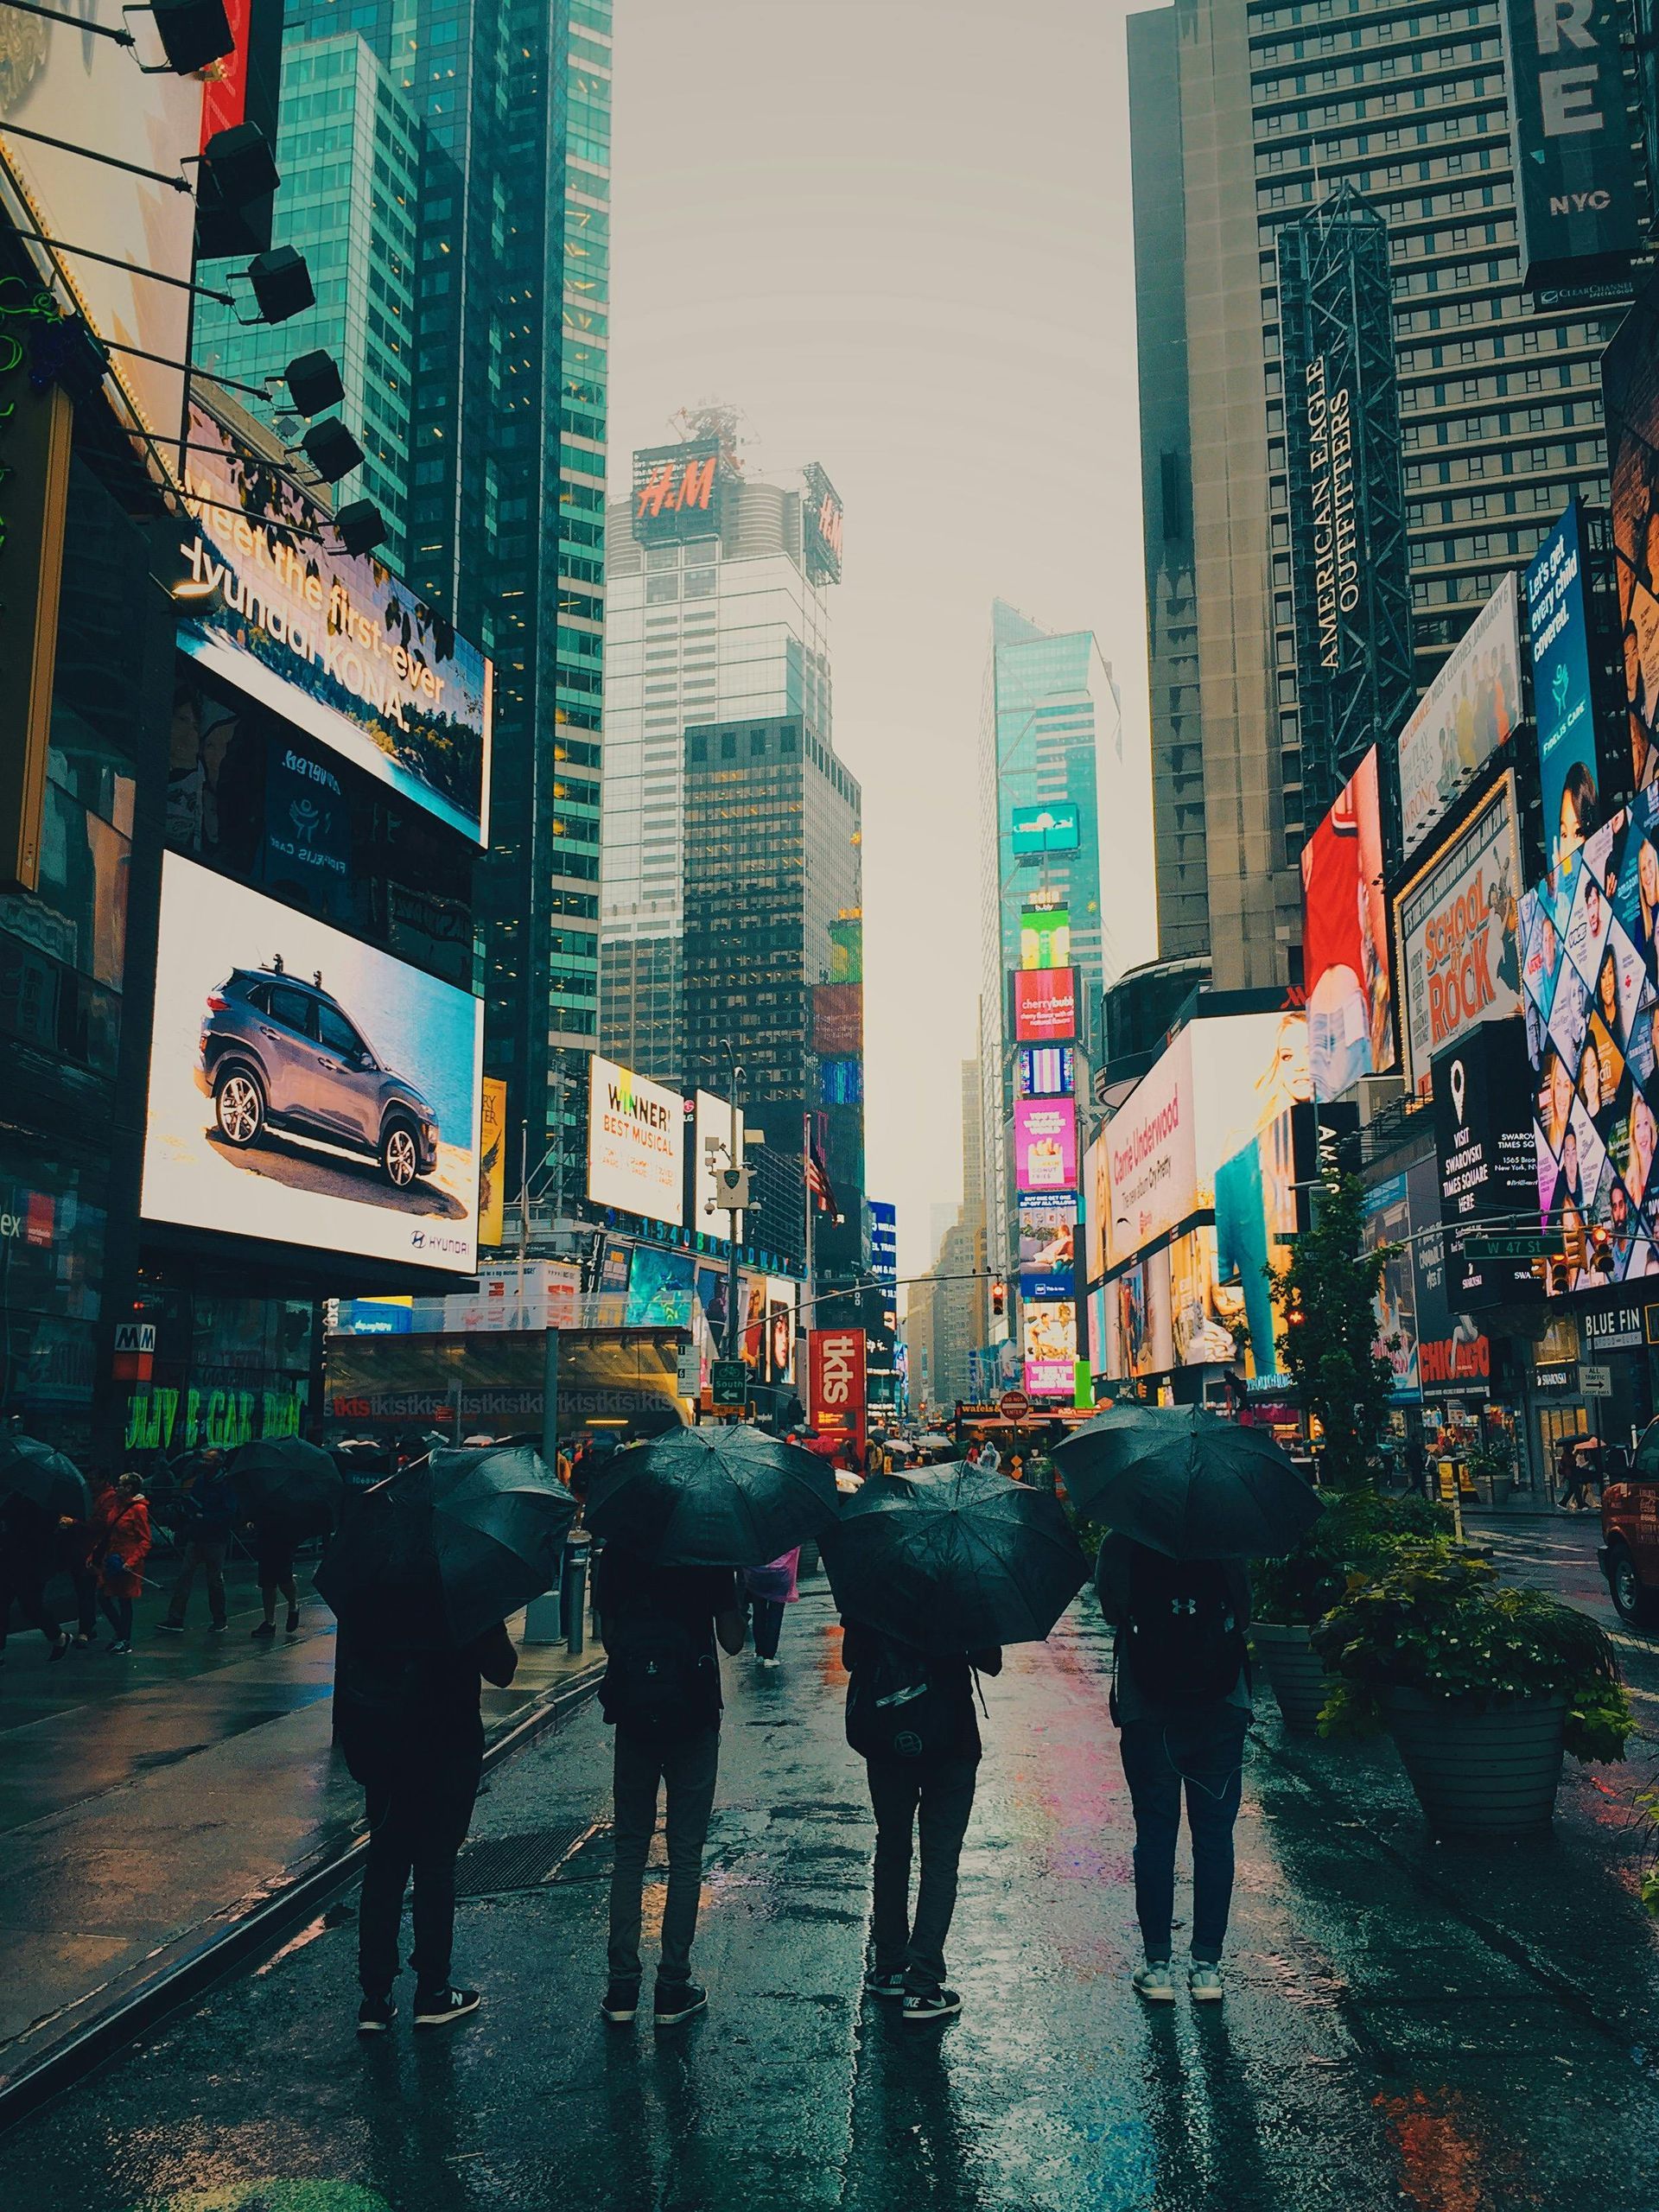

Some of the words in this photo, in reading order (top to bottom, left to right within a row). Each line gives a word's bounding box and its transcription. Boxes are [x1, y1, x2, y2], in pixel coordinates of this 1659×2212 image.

[1549, 190, 1611, 215] NYC
[1306, 354, 1329, 472] EAGLE
[637, 457, 716, 518] H&M
[1330, 388, 1358, 613] OUTFITTERS
[1312, 475, 1338, 669] AMERICAN
[1529, 561, 1549, 604] Let's
[1550, 534, 1566, 578] get
[1532, 587, 1554, 632] every
[1555, 549, 1578, 600] child
[273, 543, 322, 611] the
[330, 585, 445, 703] first-ever
[1473, 596, 1503, 647] JANUARY
[1534, 599, 1570, 664] covered.
[1426, 868, 1490, 971] SCHOOL
[1428, 928, 1496, 1045] ROCK
[608, 1083, 671, 1134] WINNER!
[1134, 1083, 1179, 1167] Underwood
[604, 1114, 630, 1139] BEST
[632, 1126, 674, 1157] MUSICAL
[1453, 1127, 1469, 1149] VISIT
[1443, 1177, 1461, 1198] TIMES
[1461, 1164, 1489, 1191] SQUARE
[1446, 1143, 1482, 1176] SWAROVSKI
[1459, 1192, 1475, 1214] HERE
[429, 1236, 470, 1255] HYUNDAI
[642, 1217, 690, 1247] 1540
[1487, 1242, 1500, 1254] W
[1506, 1241, 1521, 1254] 47
[1528, 1240, 1541, 1253] St
[1586, 1312, 1615, 1337] BLUE
[1619, 1307, 1640, 1331] FIN
[823, 1336, 855, 1404] tkts
[1420, 1335, 1490, 1382] CHICAGO
[334, 1395, 372, 1417] tkts
[715, 1380, 743, 1389] South
[963, 1404, 994, 1413] wafels
[451, 1991, 463, 2005] N
